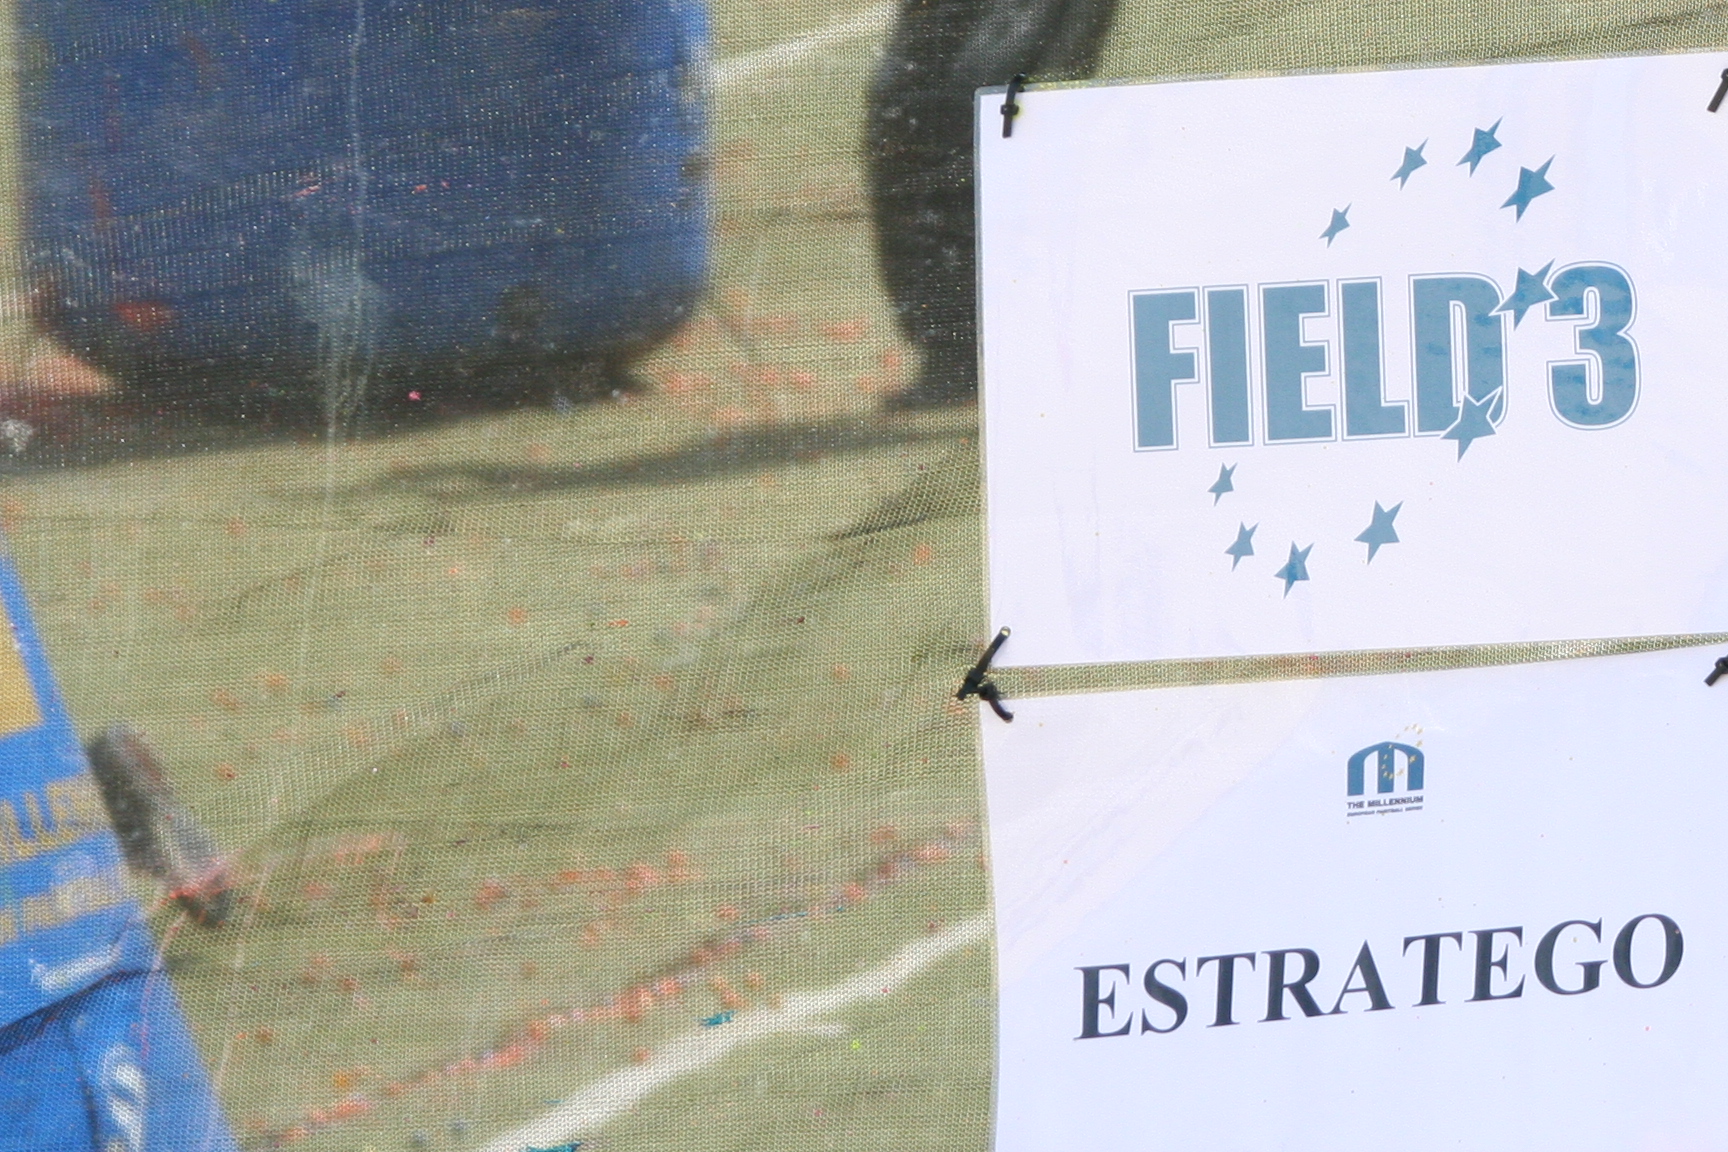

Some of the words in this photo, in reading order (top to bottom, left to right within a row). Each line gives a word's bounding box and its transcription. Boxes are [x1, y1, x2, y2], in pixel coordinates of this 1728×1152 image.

[1128, 272, 1508, 452] FIELD
[1545, 261, 1641, 431] 3
[1347, 800, 1365, 809] THE
[1367, 795, 1424, 808] MILLENNIUM
[1073, 913, 1685, 1041] ESTRATEGO
